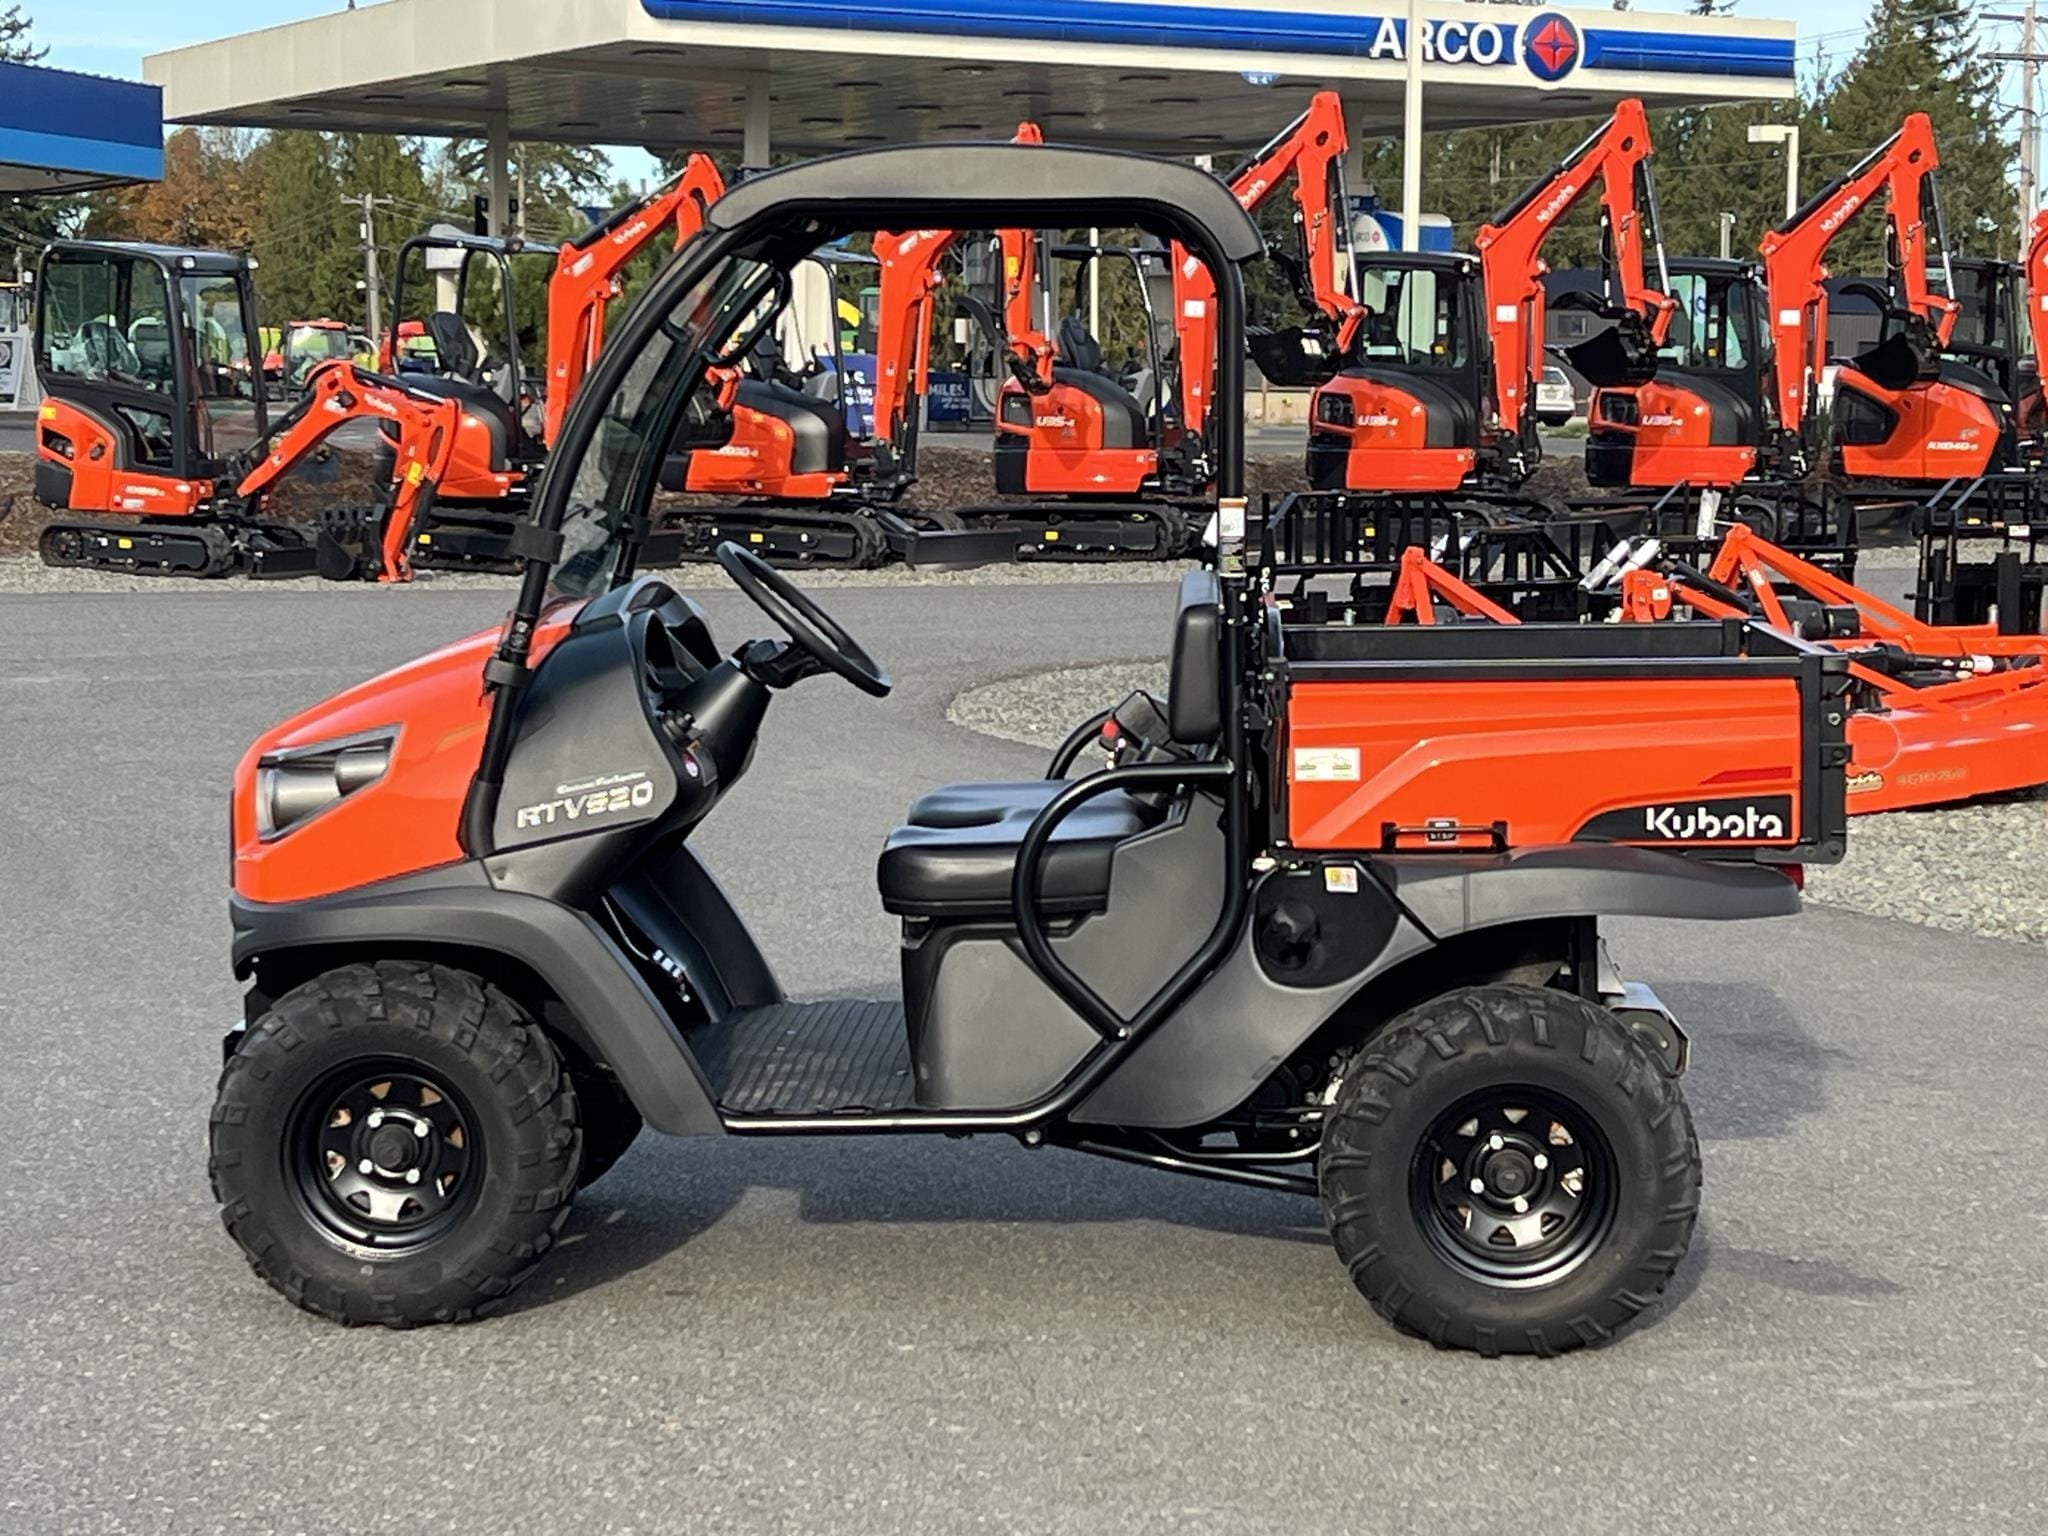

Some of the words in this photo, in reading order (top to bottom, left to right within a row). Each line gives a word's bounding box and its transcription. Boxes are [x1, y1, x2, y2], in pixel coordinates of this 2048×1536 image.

[1370, 16, 1503, 65] ARCO
[516, 780, 654, 829] RTV520
[1645, 806, 1784, 839] Kubota
